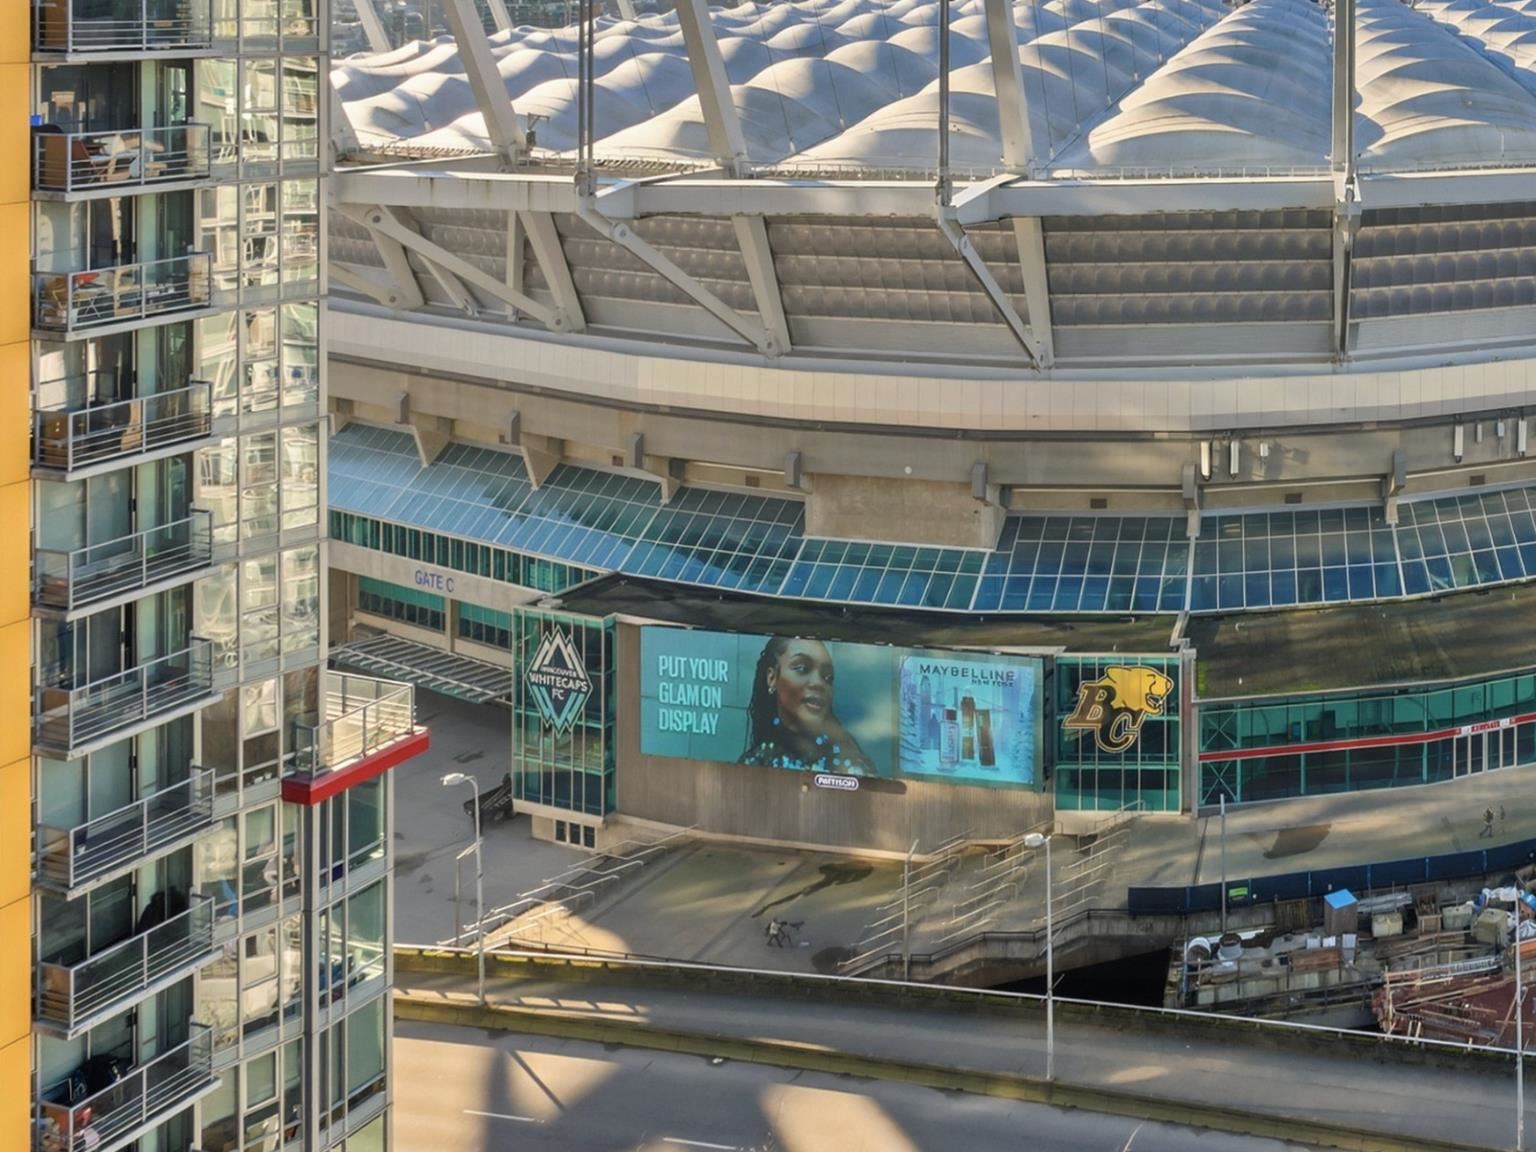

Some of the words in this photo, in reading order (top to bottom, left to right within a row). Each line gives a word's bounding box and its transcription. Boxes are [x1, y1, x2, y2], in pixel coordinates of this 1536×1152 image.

[415, 569, 443, 590] GATE
[446, 577, 455, 593] C
[658, 655, 687, 678] PUT
[689, 657, 728, 683] YOUR
[920, 663, 1015, 682] MAYBELLINE
[529, 672, 588, 692] WHITECAPS
[551, 687, 565, 700] FC
[658, 681, 699, 707] GLAM
[701, 685, 722, 709] ON
[658, 708, 719, 736] DISPLAY
